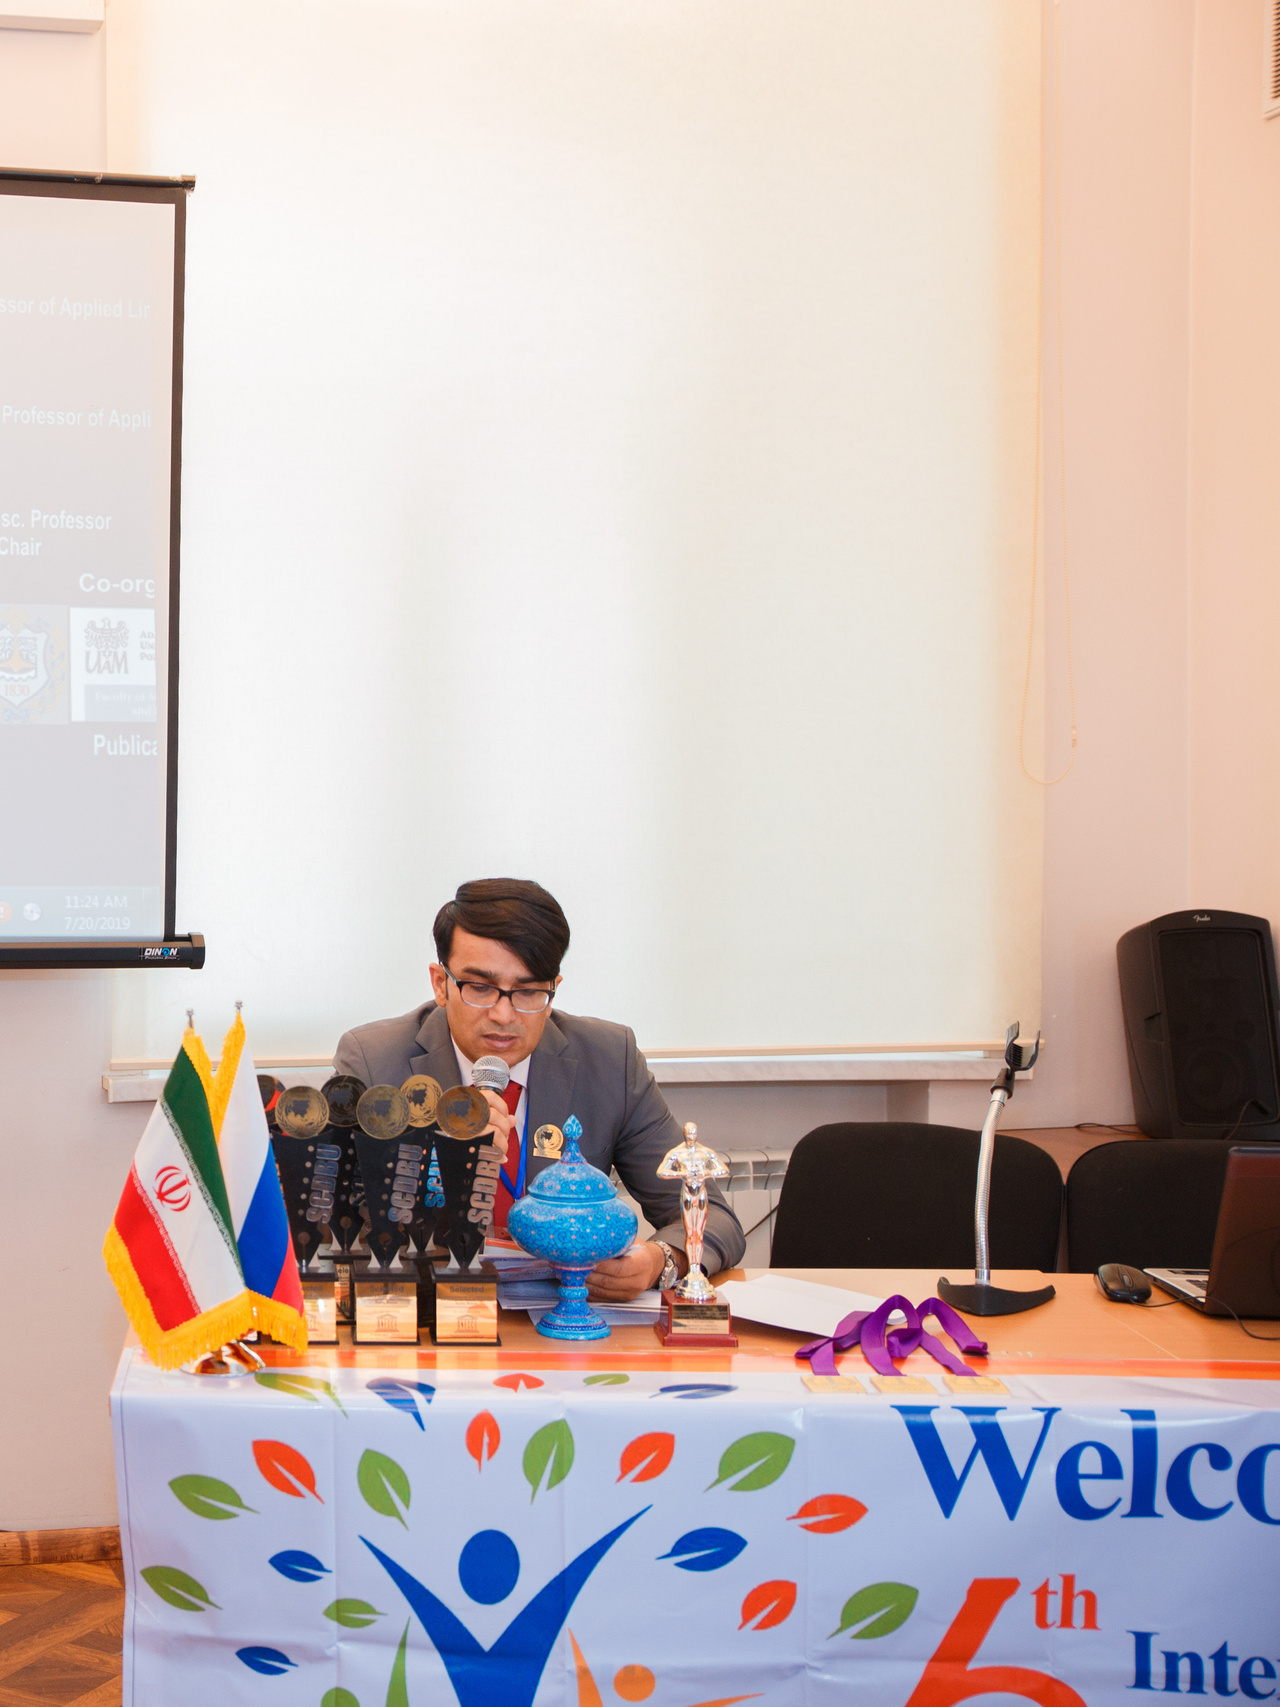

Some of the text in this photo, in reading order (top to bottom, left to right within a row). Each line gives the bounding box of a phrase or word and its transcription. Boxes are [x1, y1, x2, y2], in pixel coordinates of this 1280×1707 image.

[39, 296, 56, 315] of
[59, 297, 122, 321] Applied
[2, 405, 83, 426] Professor
[88, 409, 104, 426] of
[109, 409, 152, 432] Appli
[30, 509, 112, 530] Professor
[4, 684, 30, 697] 1830
[65, 895, 128, 909] 11:24 AM
[65, 917, 131, 931] 7/20/2019
[449, 1285, 485, 1294] Selected
[889, 1404, 1280, 1526] Welco
[1124, 1629, 1280, 1701] Inte
